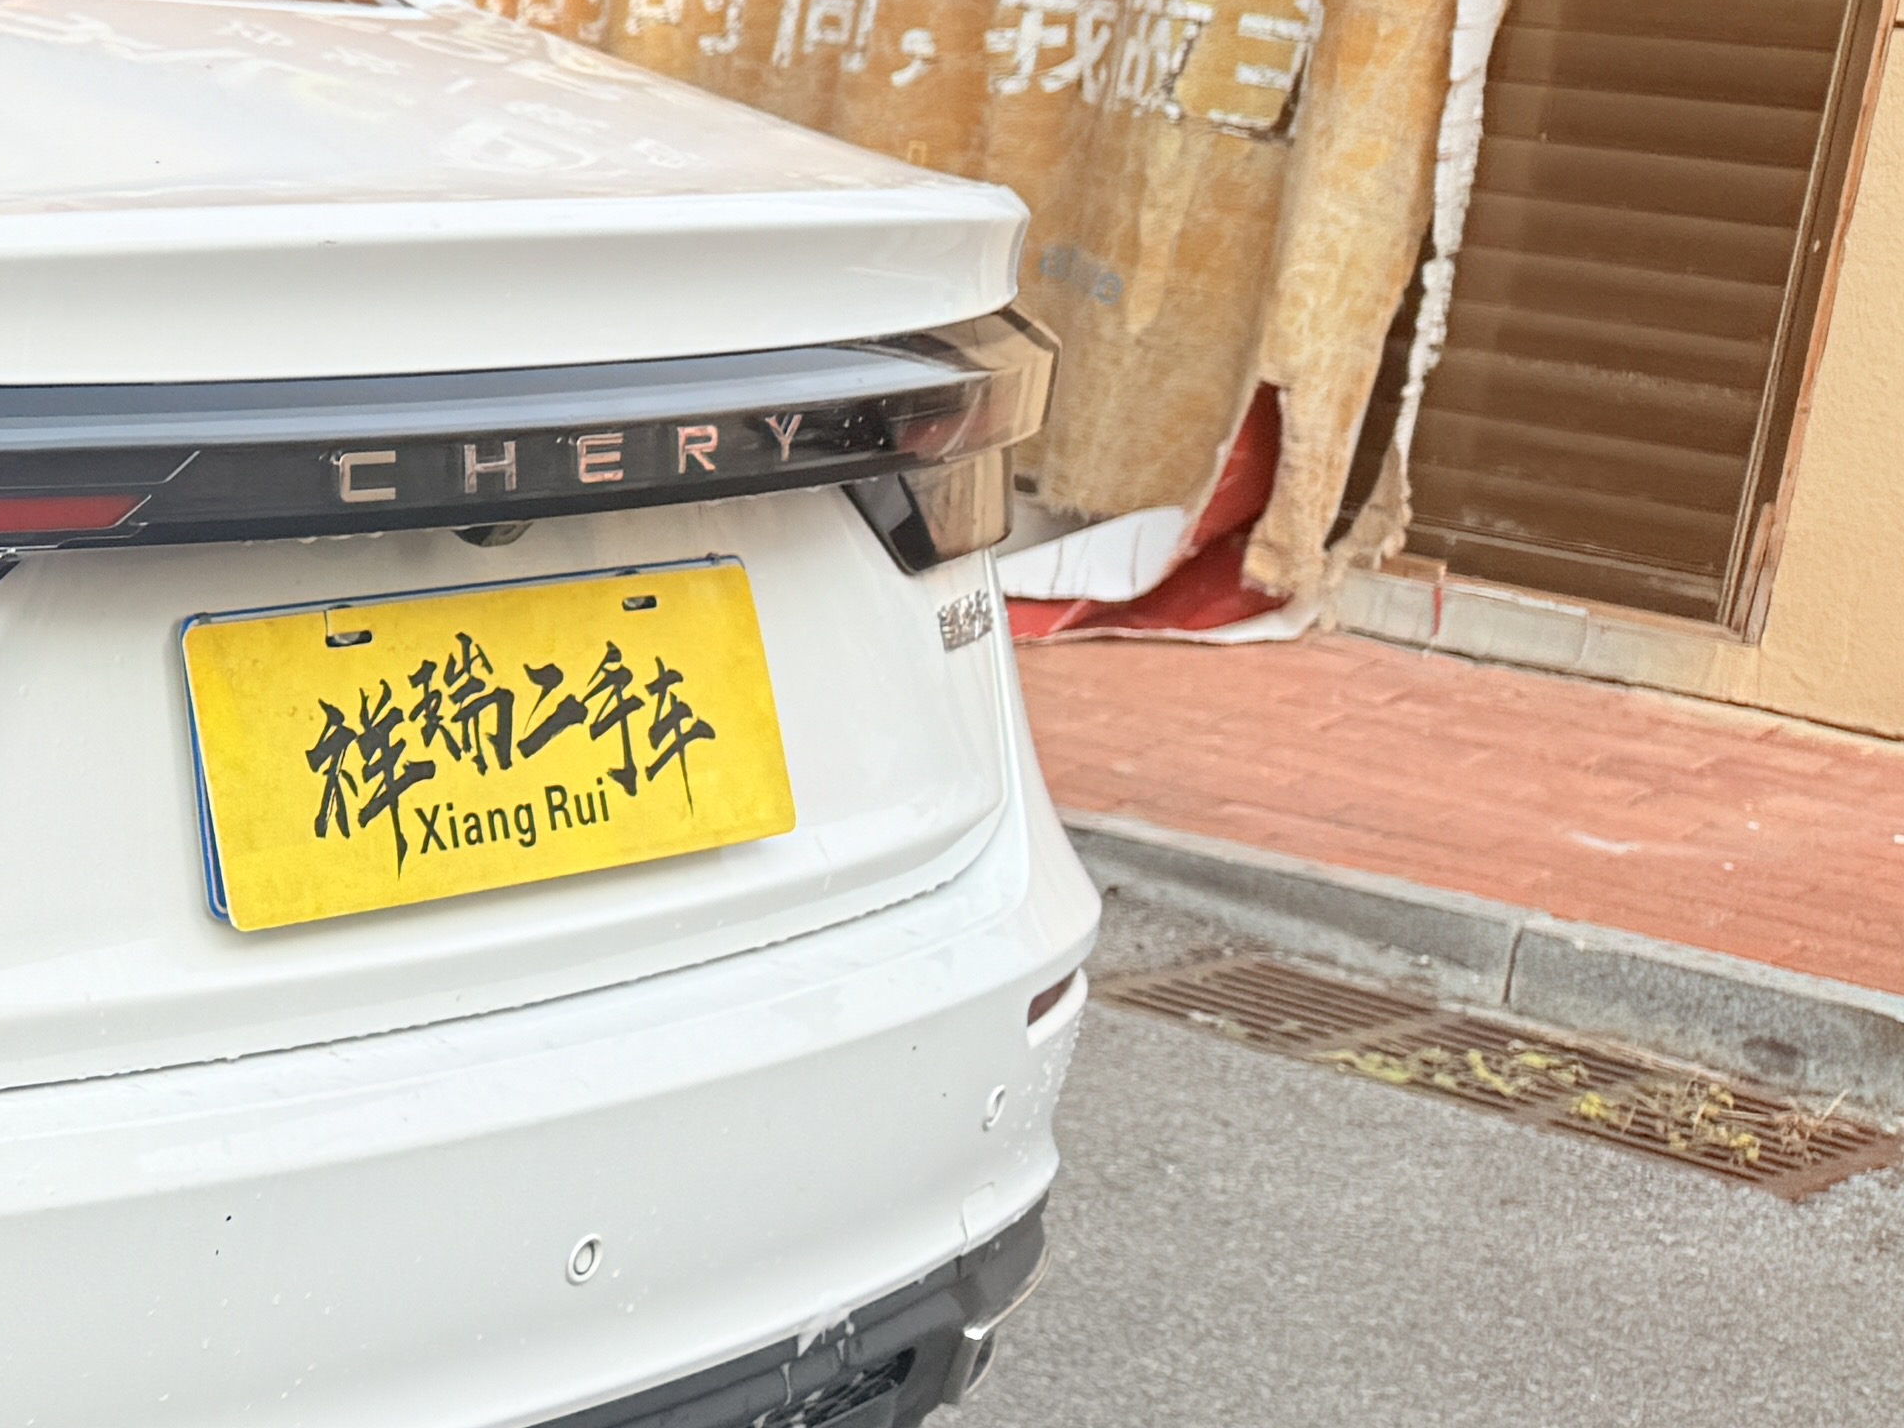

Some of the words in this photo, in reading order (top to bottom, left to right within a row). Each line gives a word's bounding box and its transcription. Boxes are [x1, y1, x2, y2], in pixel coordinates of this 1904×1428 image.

[337, 414, 804, 505] CHERY
[305, 630, 716, 880] 祥瑞二手车
[413, 802, 537, 855] Xiang
[545, 776, 612, 832] Rui
